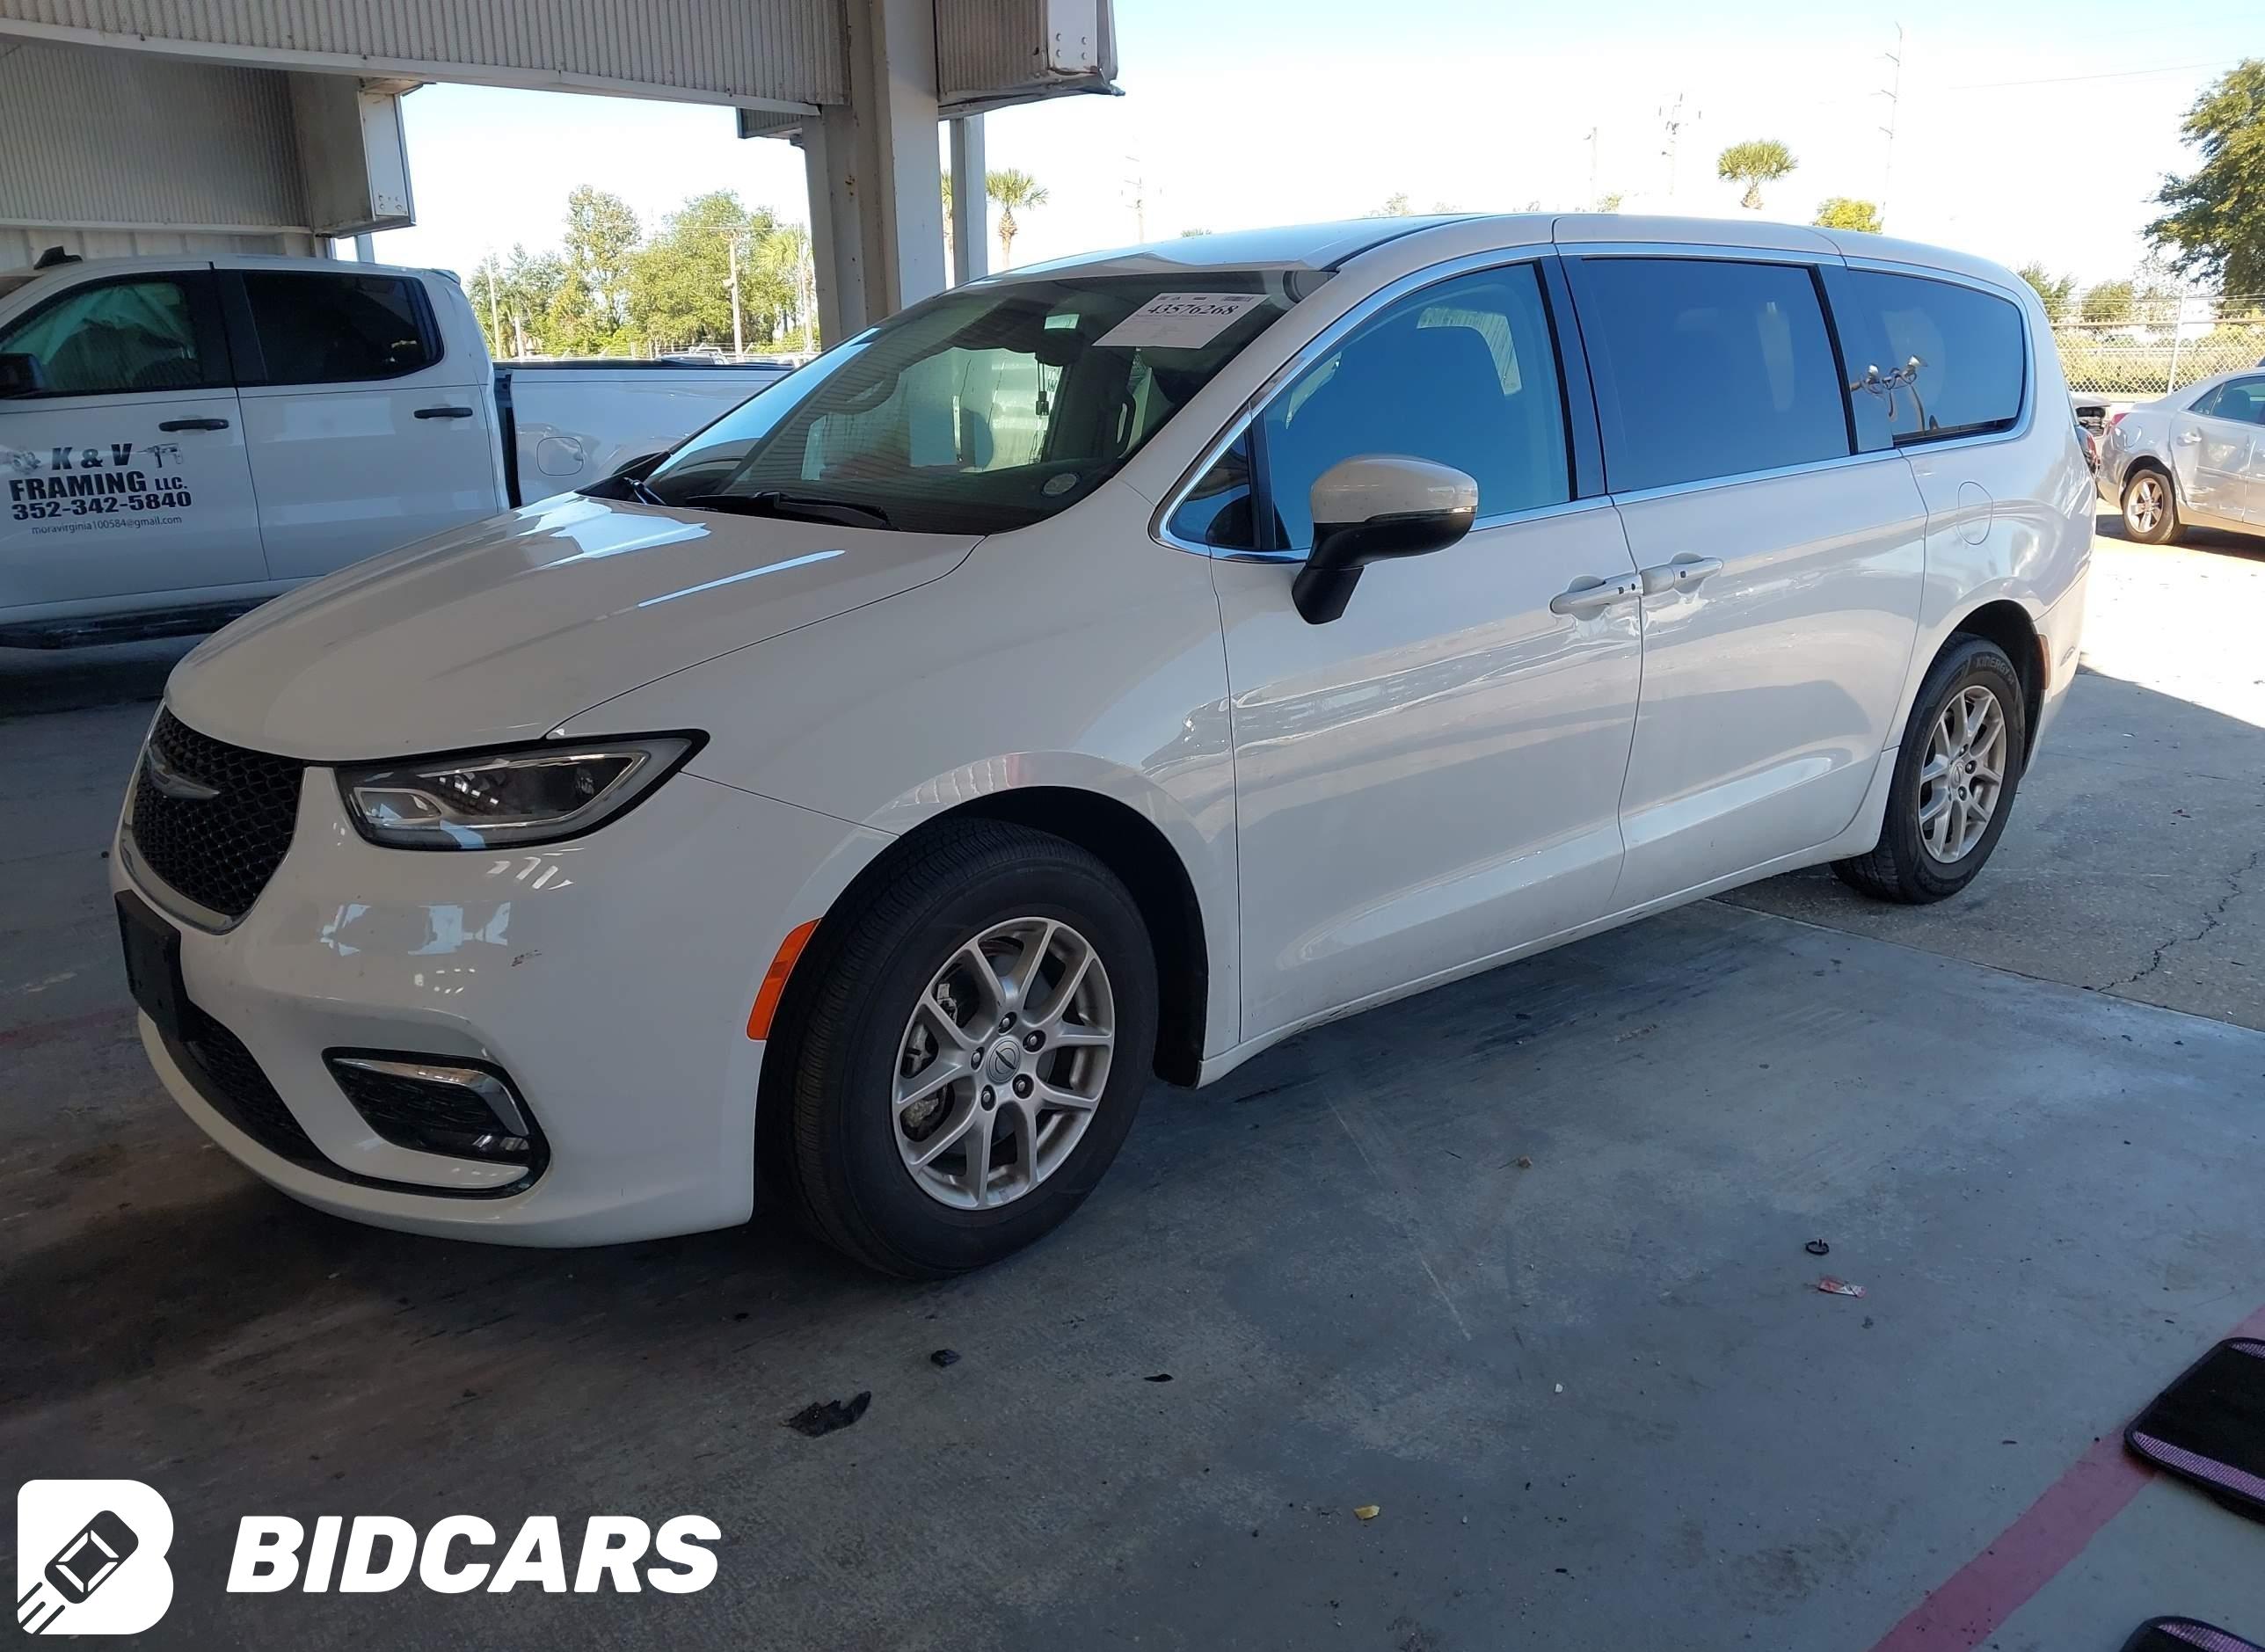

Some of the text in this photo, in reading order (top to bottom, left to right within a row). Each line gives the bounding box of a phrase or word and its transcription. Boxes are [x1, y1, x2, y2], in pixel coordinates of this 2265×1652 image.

[1147, 303, 1239, 316] 43576268
[52, 442, 133, 470] K & V
[9, 470, 188, 501] FRAMING LLC.
[11, 491, 192, 520] 352-342-5840
